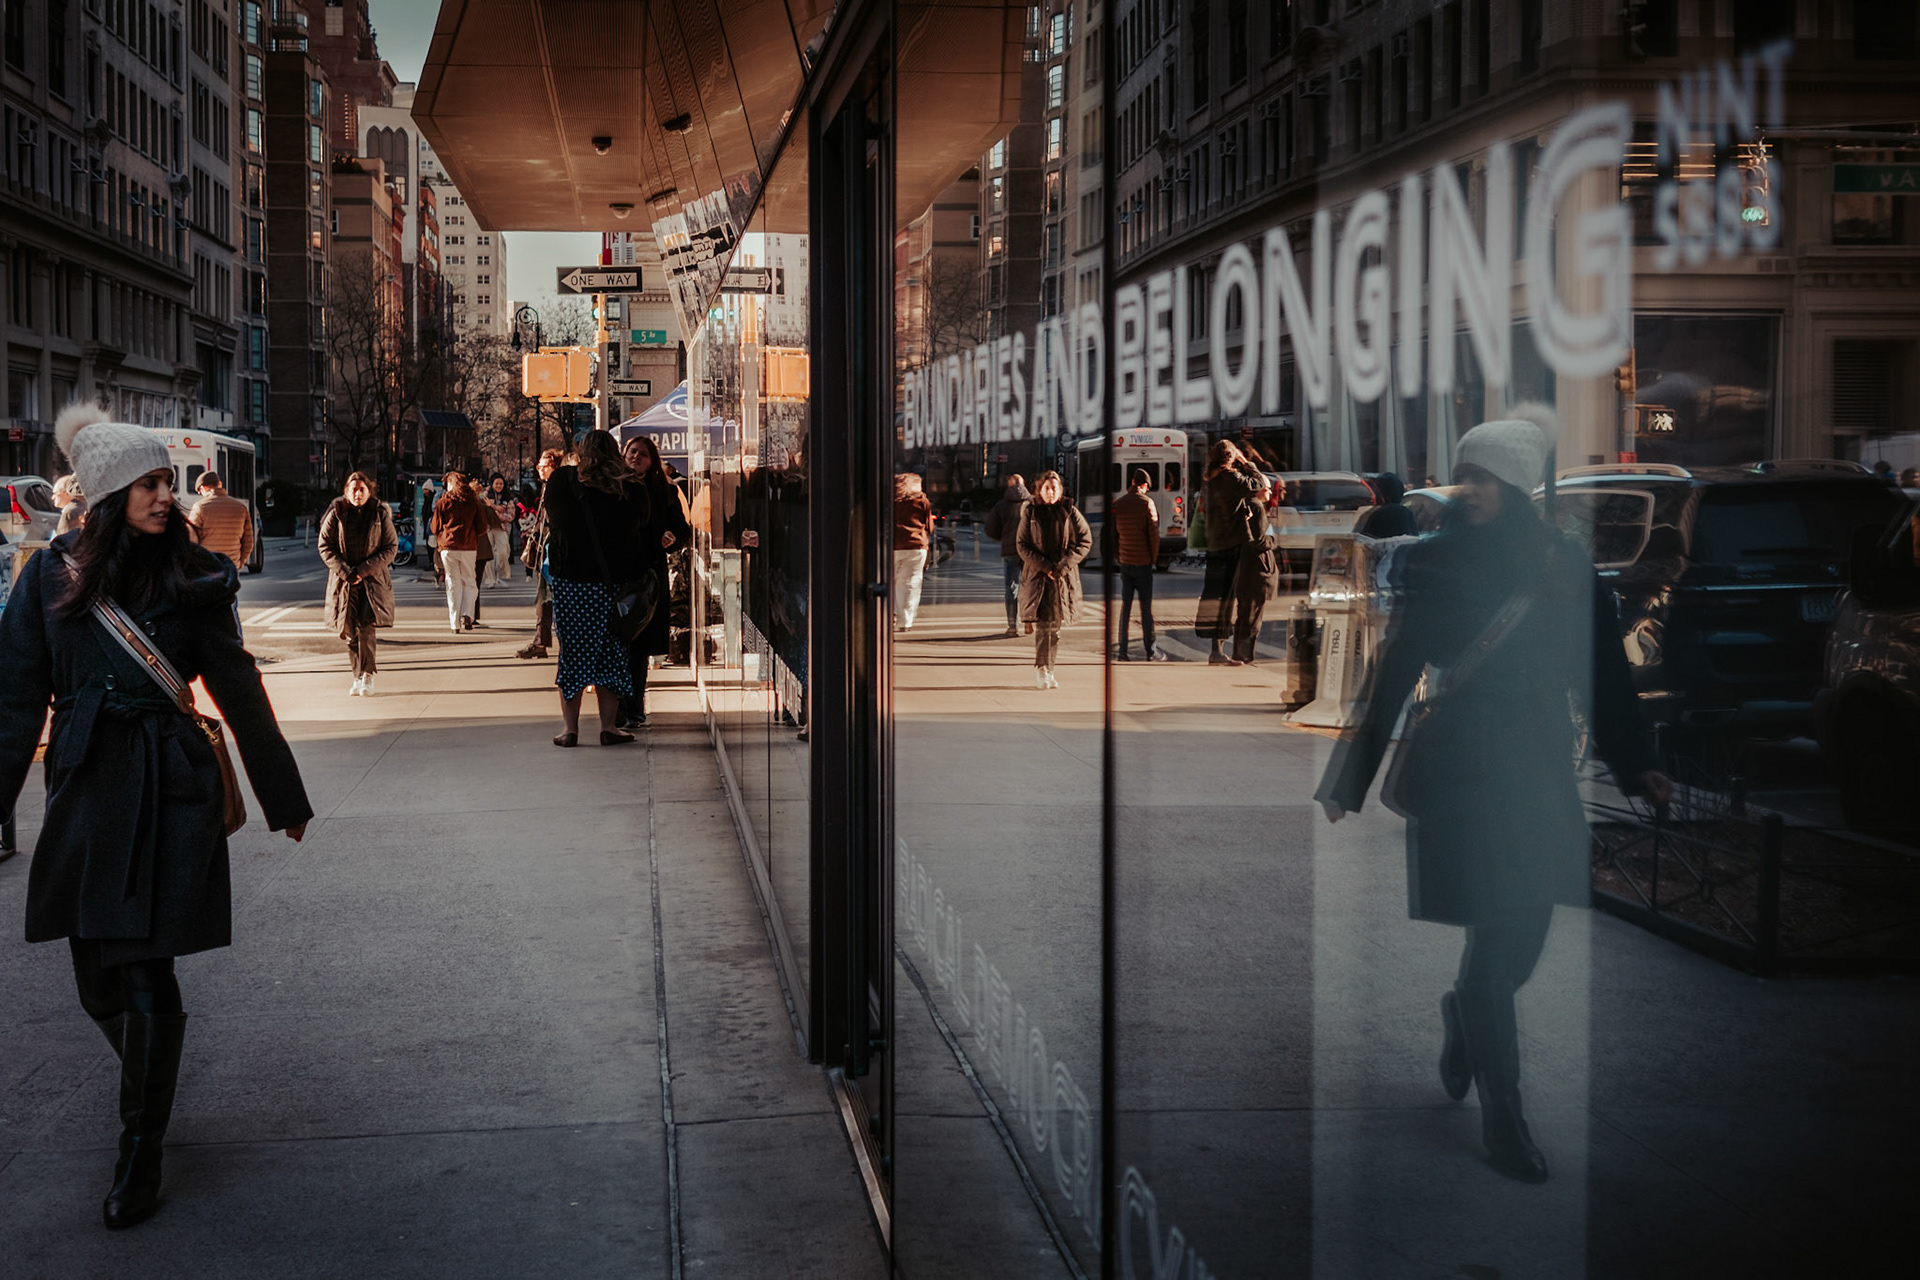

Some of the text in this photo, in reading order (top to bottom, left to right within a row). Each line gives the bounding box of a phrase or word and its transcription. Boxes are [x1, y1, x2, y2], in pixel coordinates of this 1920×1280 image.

[570, 274, 632, 286] ONE WAY
[903, 331, 1026, 450] BOUNDARIES
[1031, 302, 1105, 440] AND
[1114, 102, 1633, 429] BELONGING
[641, 331, 647, 342] 5
[629, 384, 645, 392] WAY
